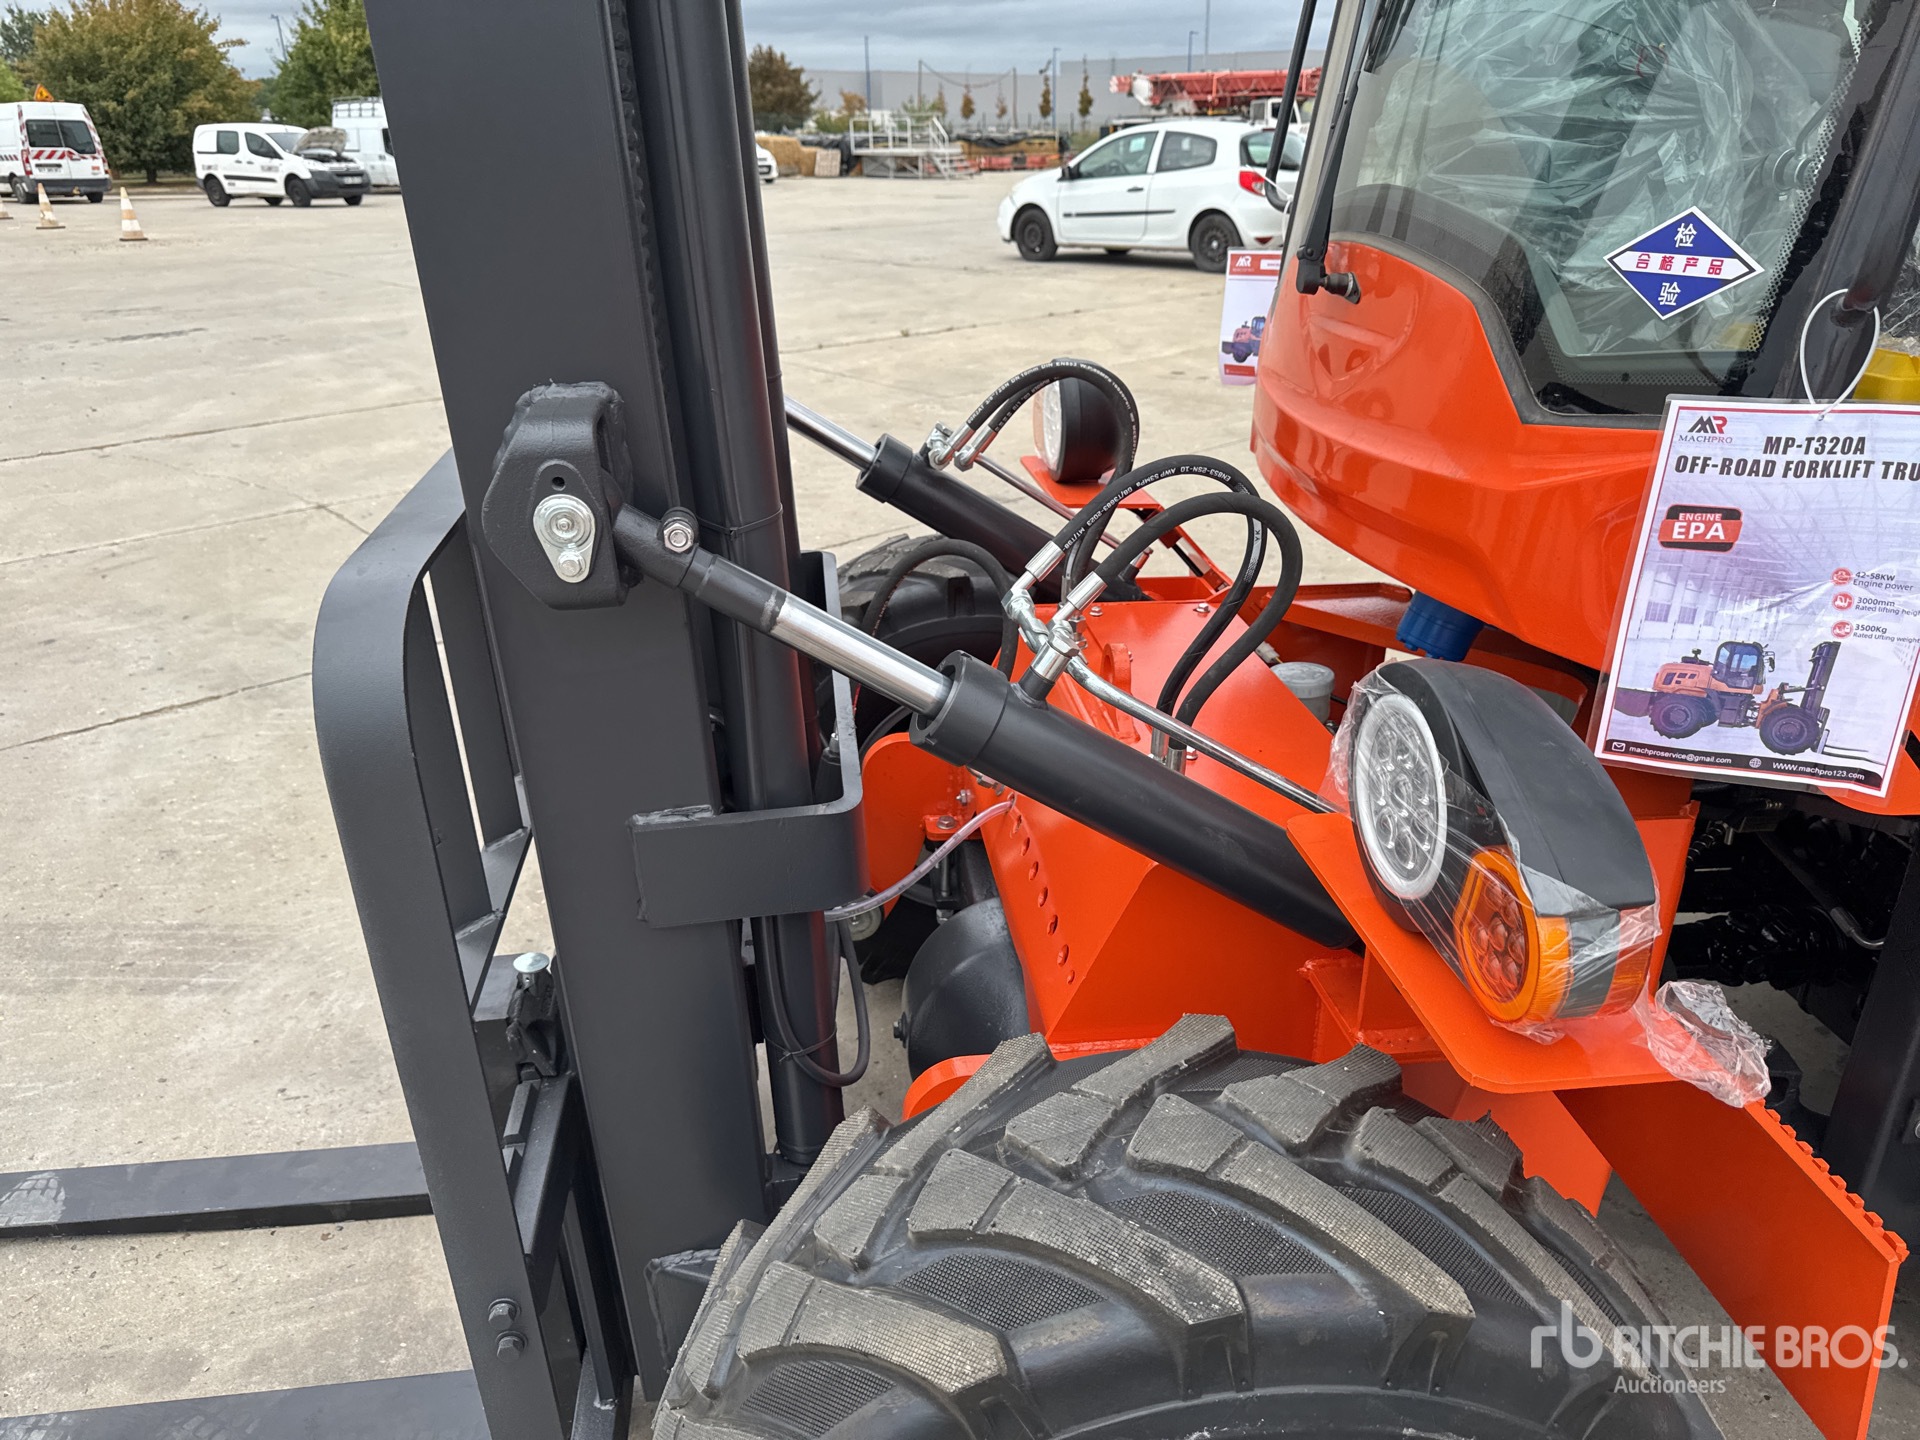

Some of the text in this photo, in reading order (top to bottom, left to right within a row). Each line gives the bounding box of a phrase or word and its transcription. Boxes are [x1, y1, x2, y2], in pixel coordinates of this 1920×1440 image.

[1674, 222, 1697, 248] 检
[1636, 253, 1724, 275] 合格产品
[1658, 281, 1681, 306] 验
[1678, 434, 1733, 444] MACHPRO
[1763, 436, 1866, 455] MP-T320A
[1161, 467, 1176, 479] AWP
[1674, 455, 1920, 481] OFF-ROAD FORKLIFT TRU
[1678, 513, 1722, 521] ENGINE
[1672, 521, 1725, 540] EPA
[1855, 571, 1896, 582] 42-58KW
[1853, 579, 1914, 591] Engine power
[1857, 596, 1895, 607] 3000mm
[1878, 606, 1900, 615] lifting
[1854, 623, 1887, 634] 3500Kg
[1628, 746, 1865, 781] machproservice@gmail.com WWW.machpro123.com
